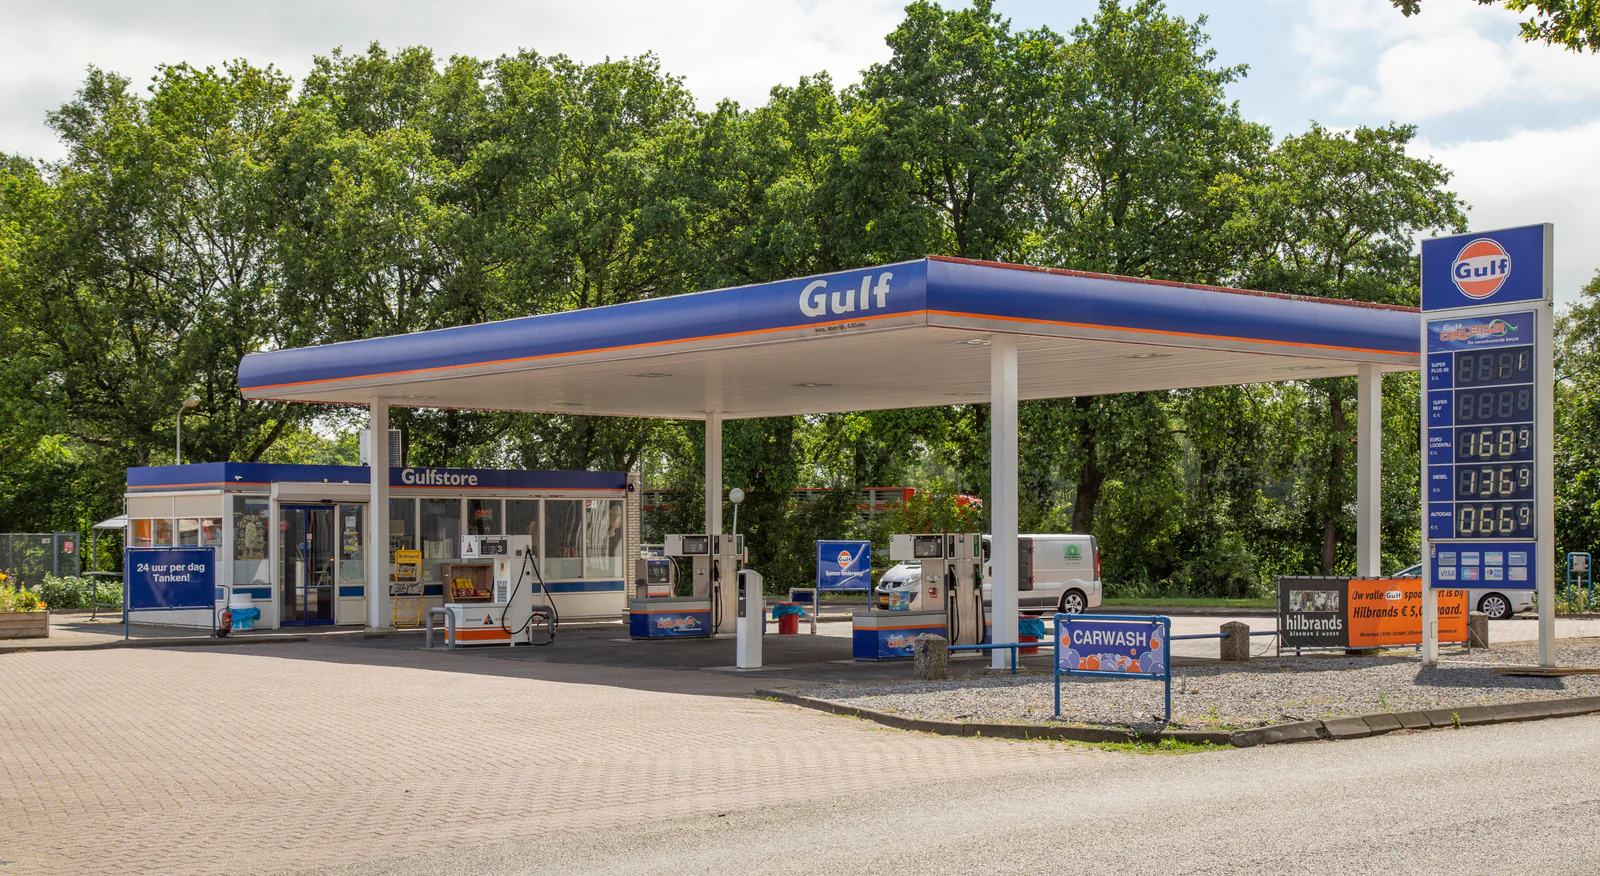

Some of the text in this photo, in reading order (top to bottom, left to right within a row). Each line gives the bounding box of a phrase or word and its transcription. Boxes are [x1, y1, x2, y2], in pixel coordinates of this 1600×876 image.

[1455, 259, 1508, 279] Gulf
[799, 272, 893, 318] Gulf
[1440, 322, 1506, 342] CHALLENGER
[1443, 323, 1462, 332] Gulf
[402, 468, 478, 486] Gulfstore
[136, 563, 149, 572] 24
[169, 565, 185, 574] per
[187, 562, 205, 574] dag
[153, 573, 190, 582] Tanken!
[1352, 590, 1364, 600] Uw
[1366, 590, 1384, 600] volle
[1353, 606, 1398, 618] Hilbrands
[1401, 606, 1408, 617] €
[1286, 614, 1342, 630] hilbrands
[1073, 629, 1147, 647] CARWASH
